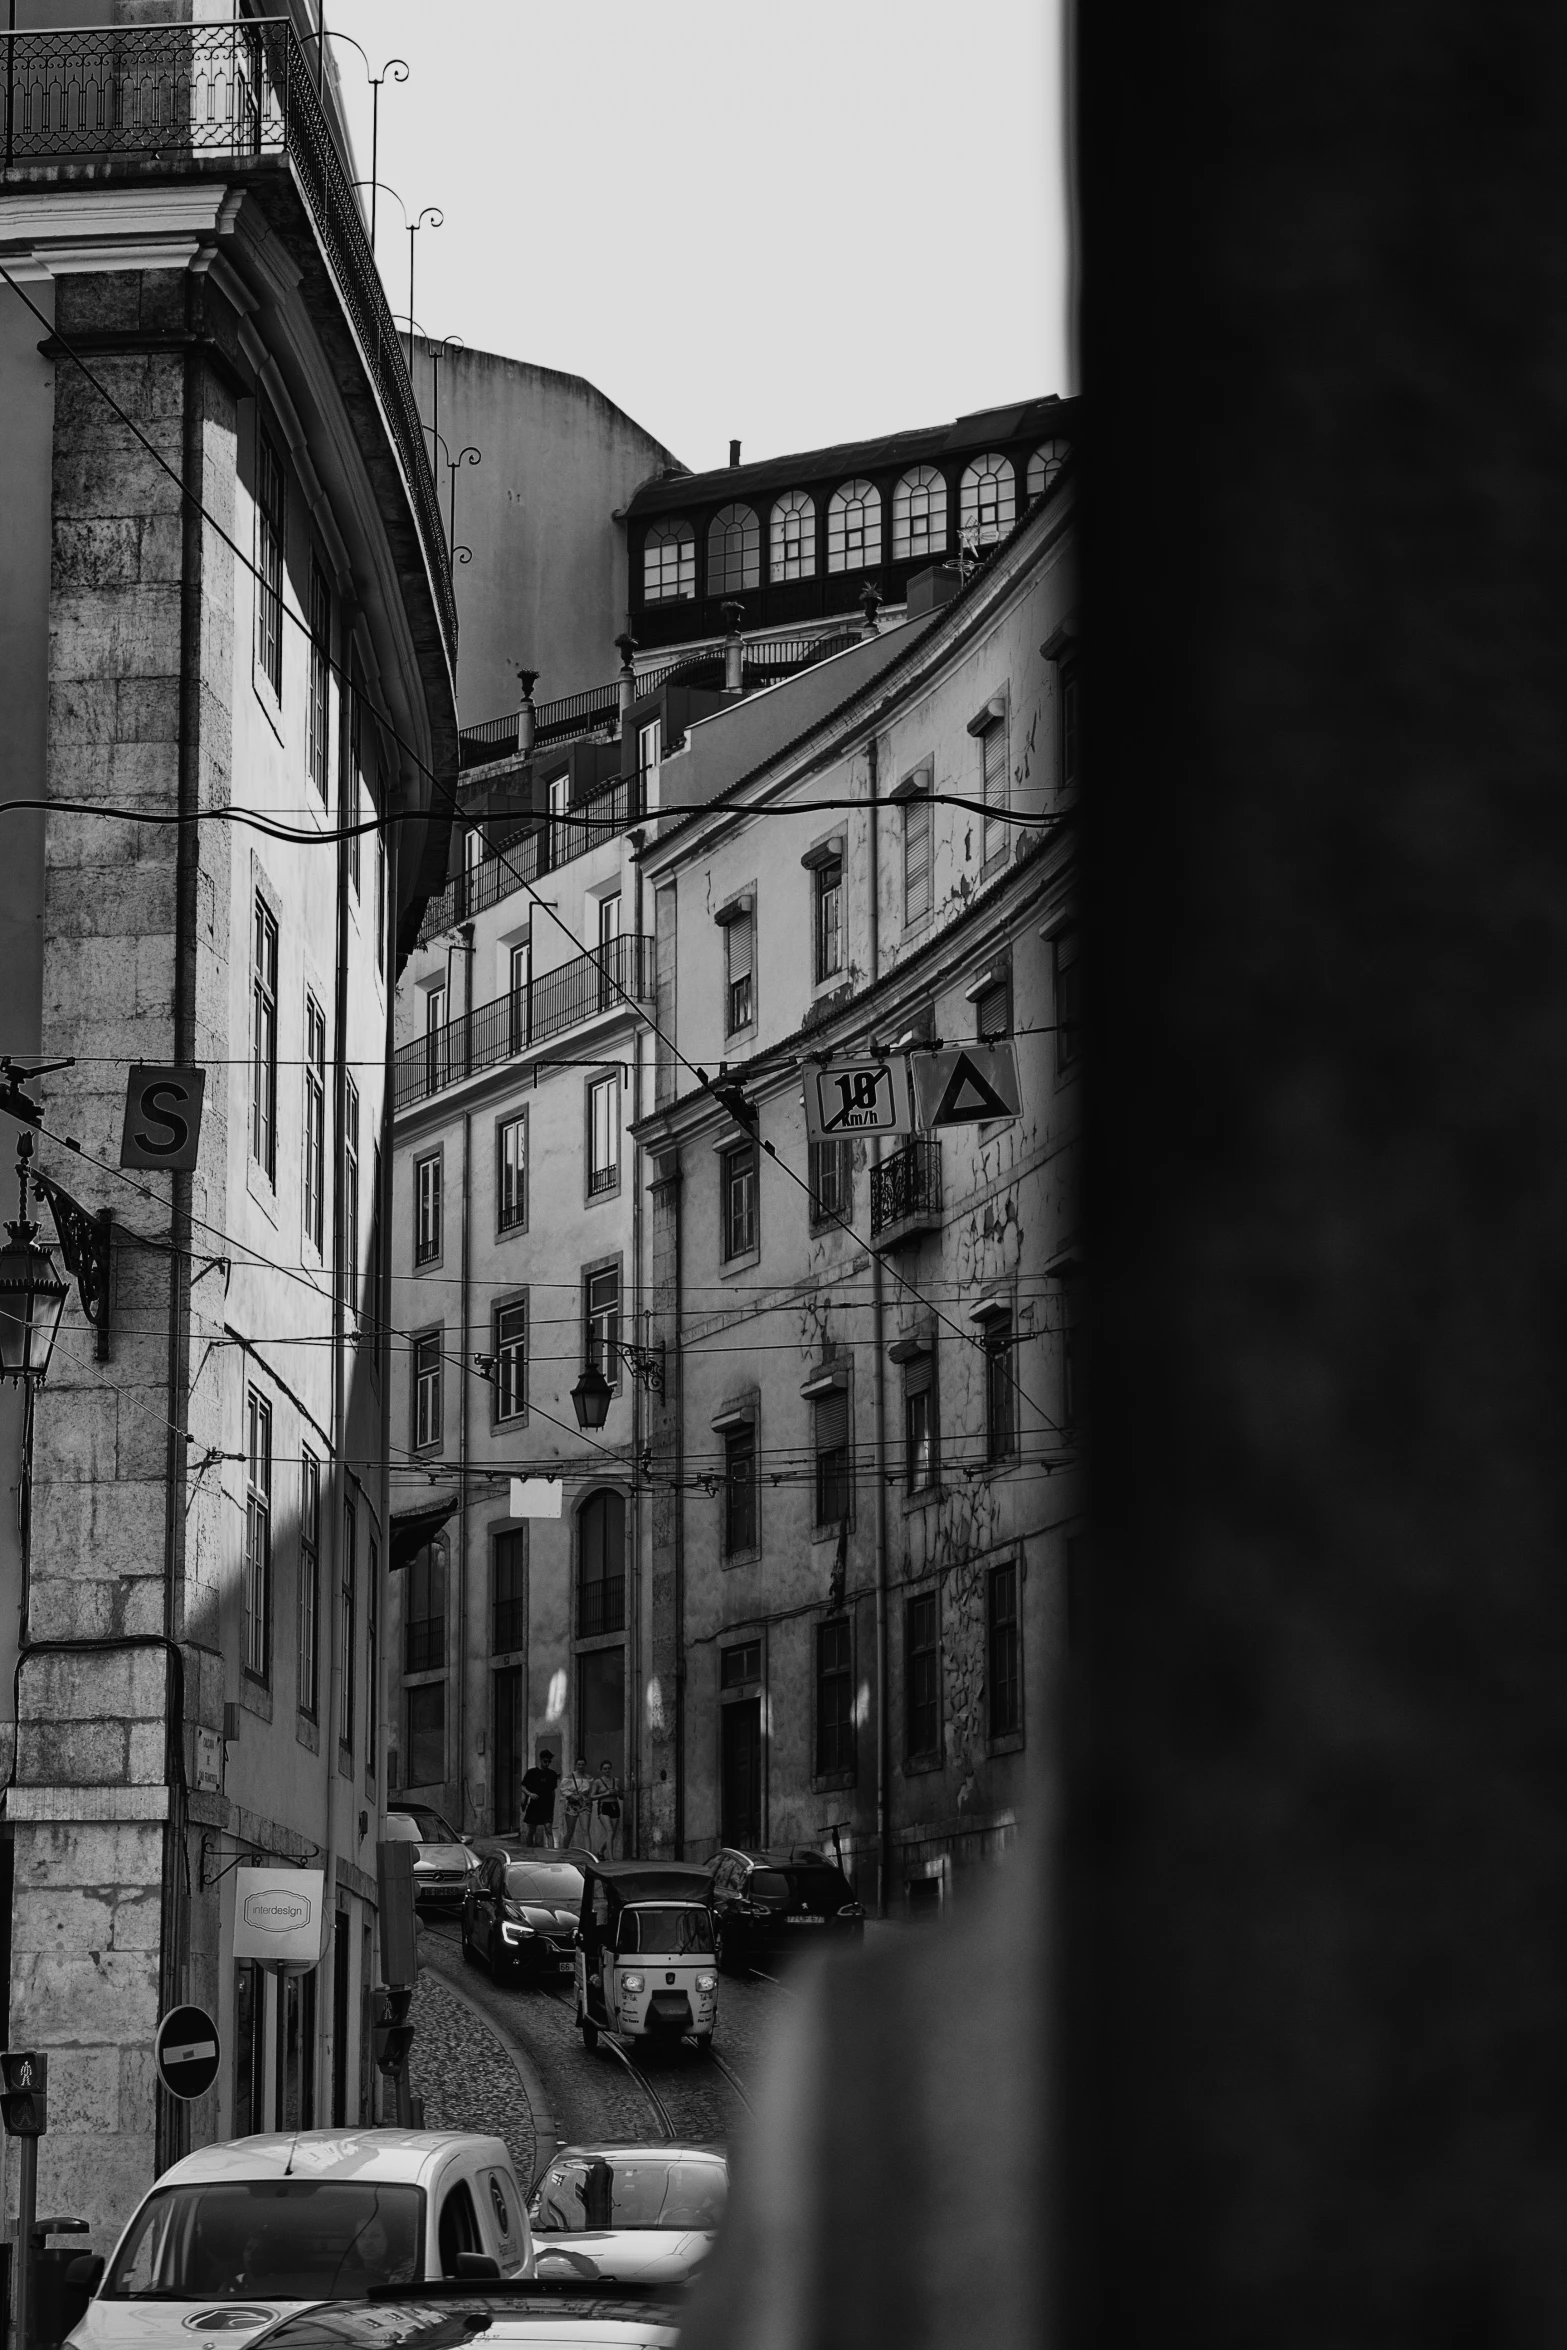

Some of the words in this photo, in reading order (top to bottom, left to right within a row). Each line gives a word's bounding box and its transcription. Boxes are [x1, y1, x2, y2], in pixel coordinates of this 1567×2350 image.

[834, 1072, 877, 1109] 10
[133, 1080, 190, 1156] S
[252, 1905, 302, 1918] interdesign
